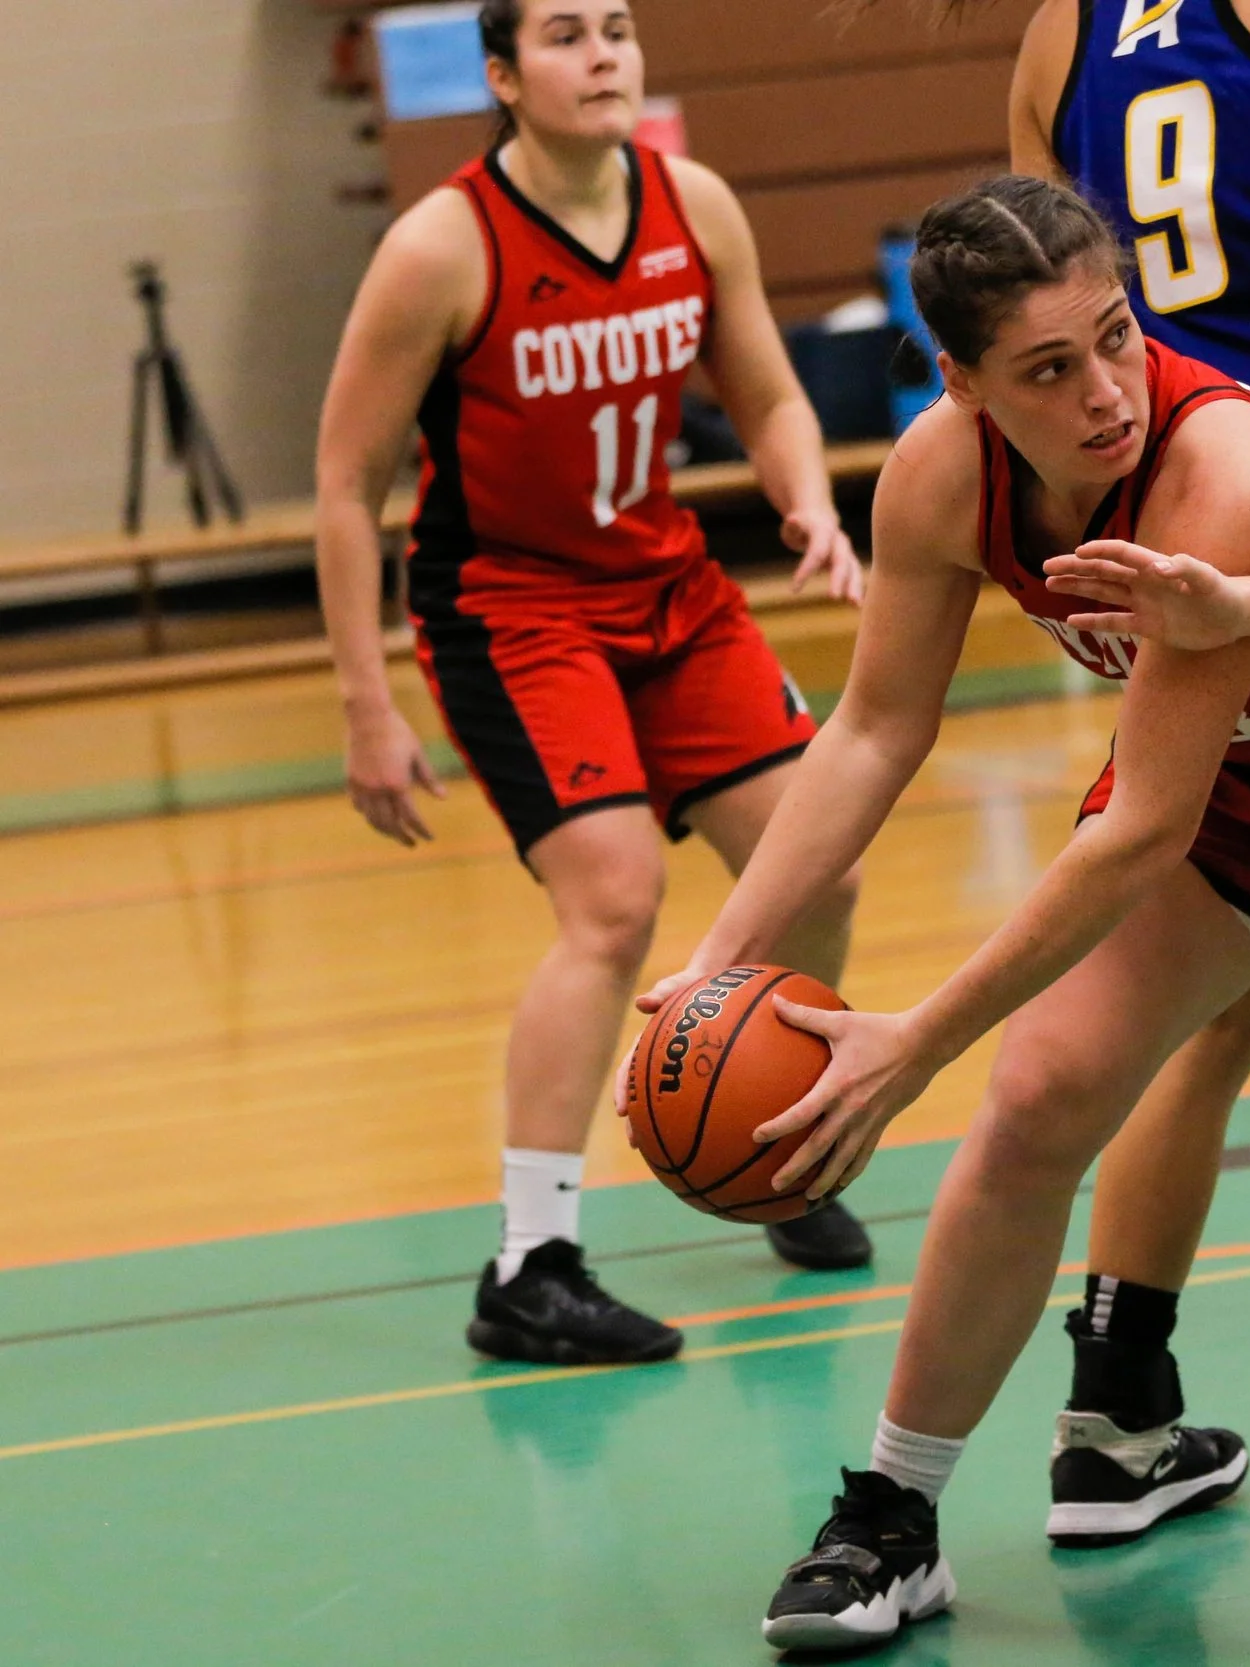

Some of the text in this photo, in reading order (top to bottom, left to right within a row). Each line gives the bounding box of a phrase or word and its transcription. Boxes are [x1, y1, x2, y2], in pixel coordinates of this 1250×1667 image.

[1125, 79, 1230, 315] 9
[513, 296, 703, 399] COYOTES
[589, 393, 658, 527] 11
[658, 966, 768, 1094] Wilson
